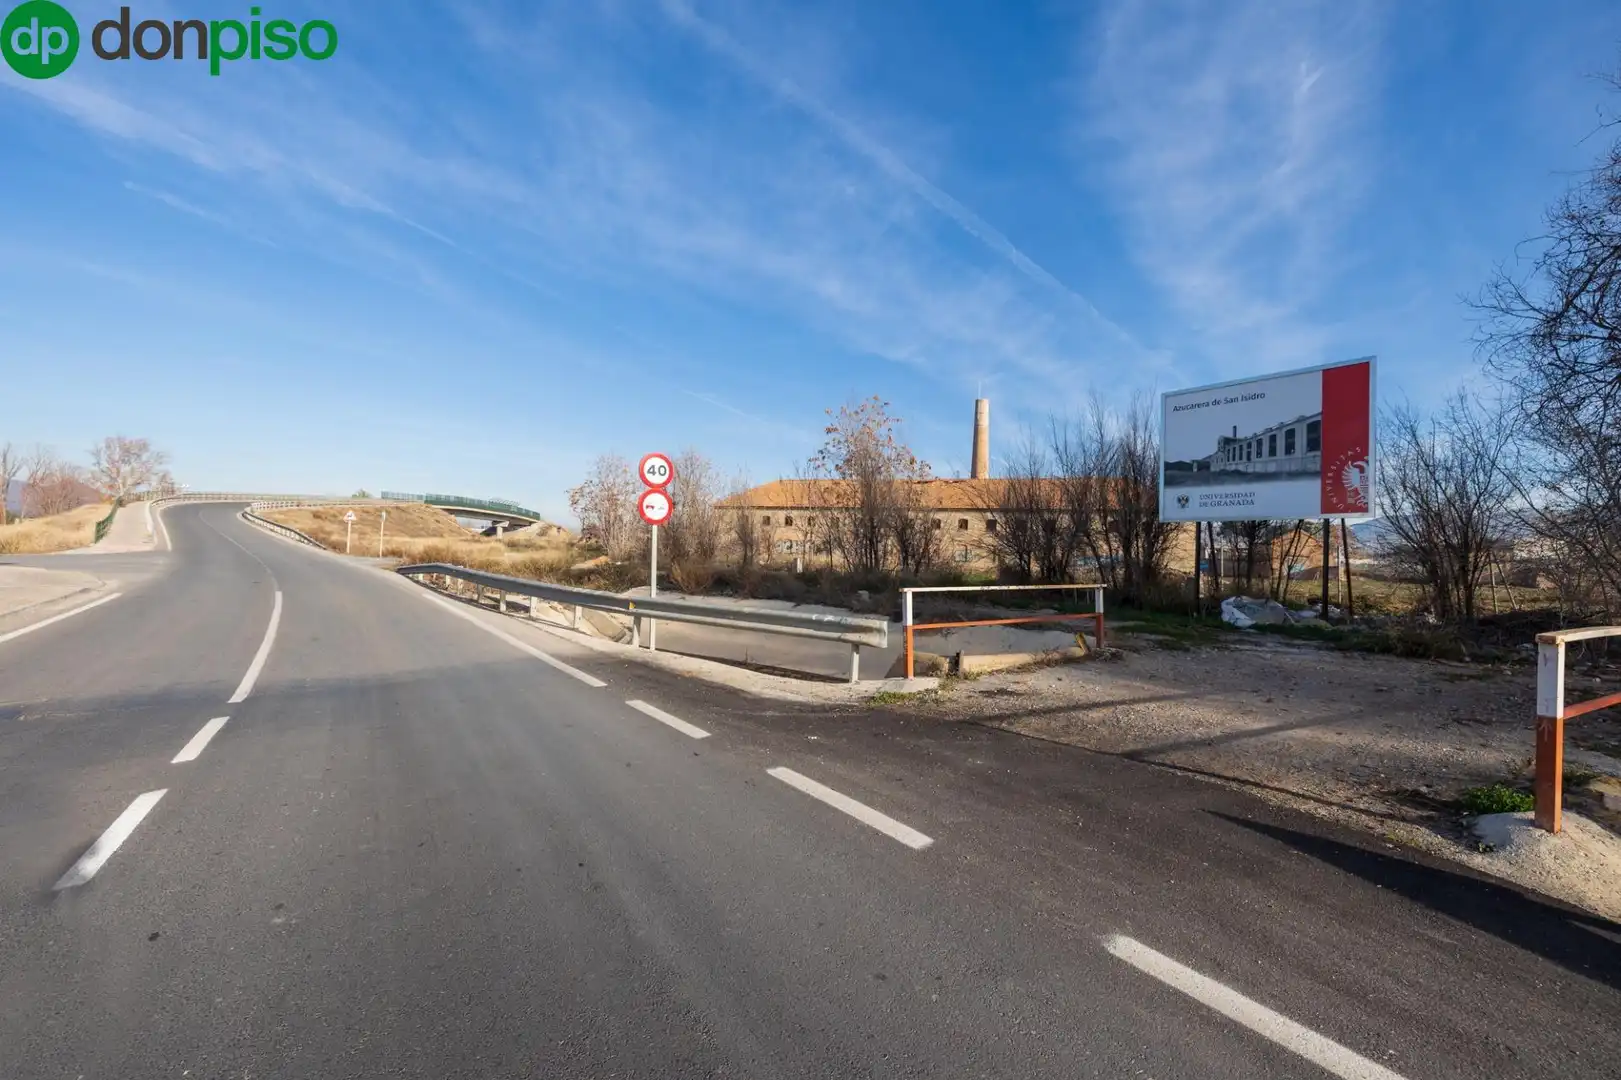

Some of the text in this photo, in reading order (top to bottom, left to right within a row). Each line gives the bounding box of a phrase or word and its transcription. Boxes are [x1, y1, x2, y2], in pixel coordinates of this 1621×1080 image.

[1173, 392, 1266, 412] Azucarera de San Isidro
[646, 464, 667, 477] 40
[1199, 492, 1256, 501] UNIVERSIDAD
[1210, 499, 1255, 508] GRANADA
